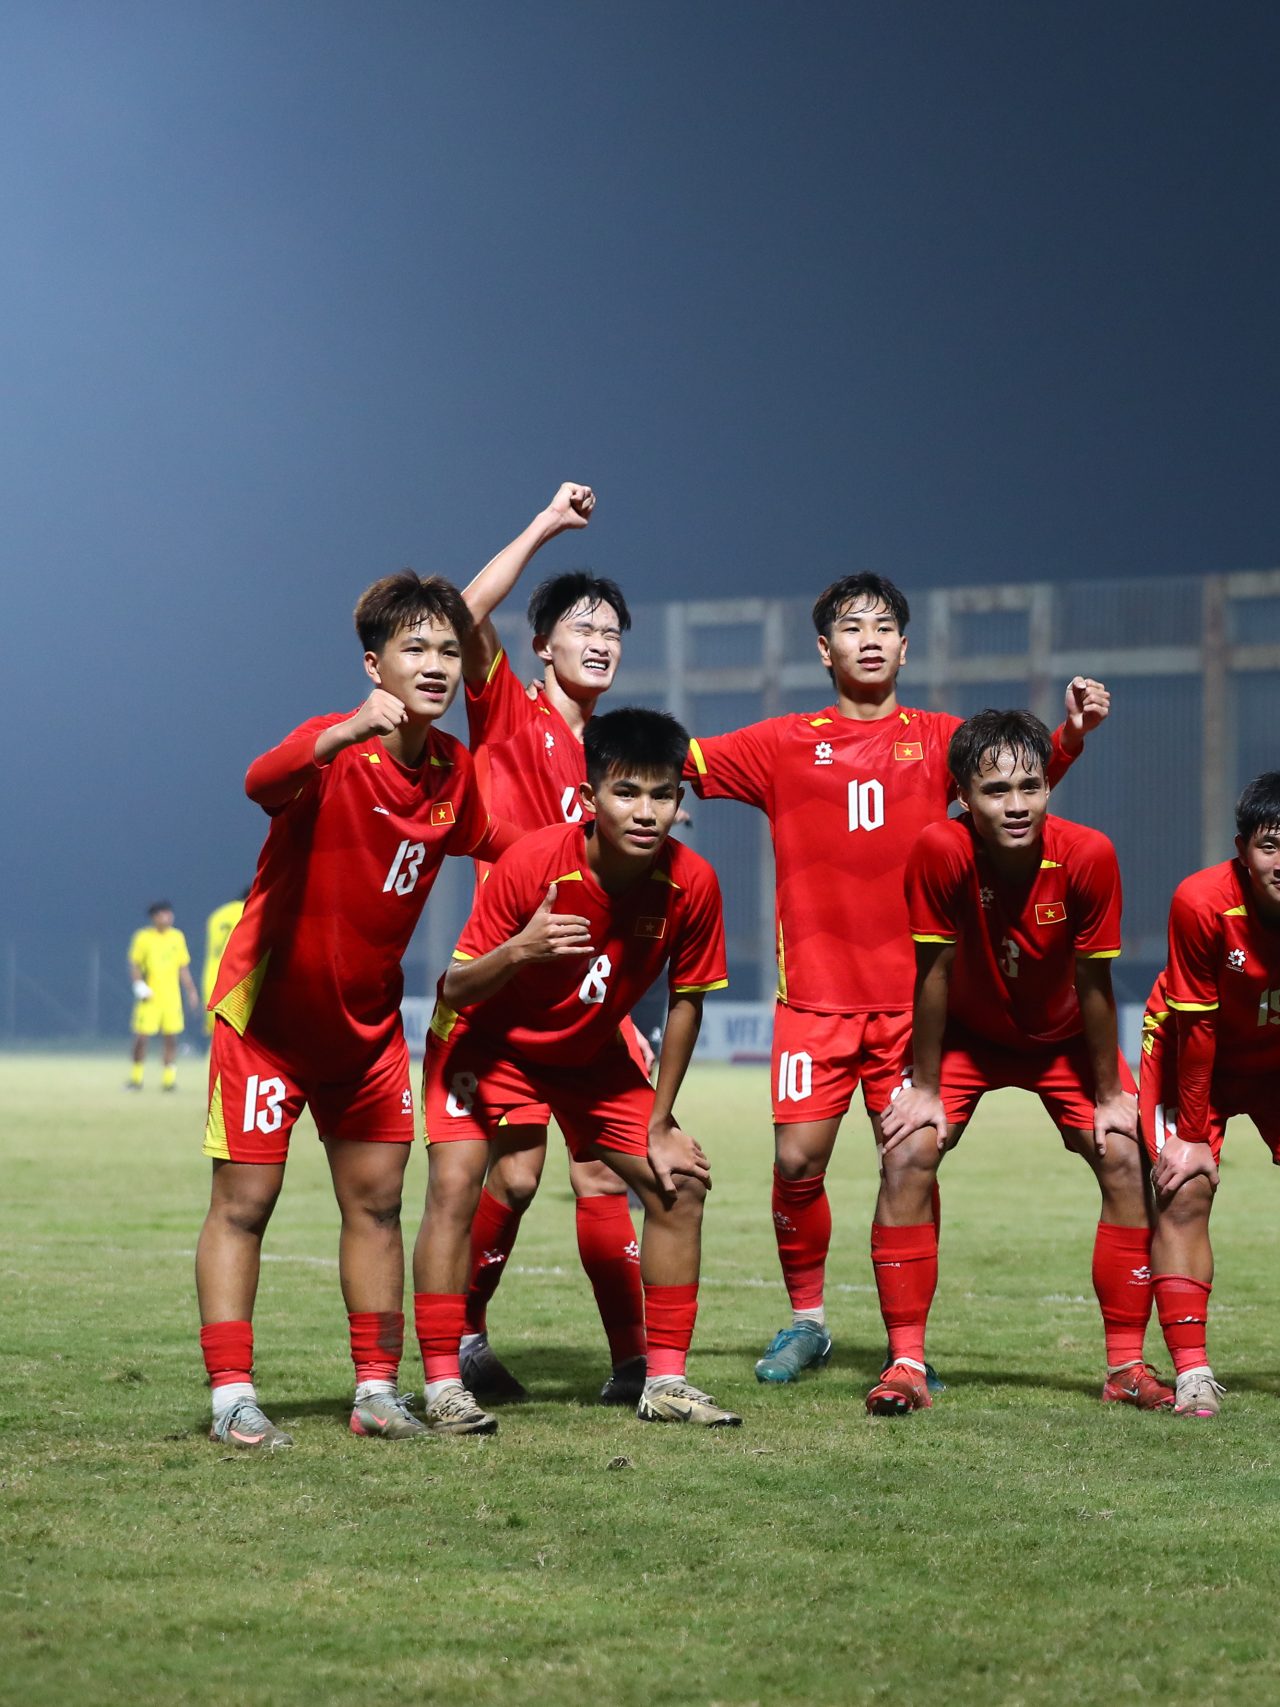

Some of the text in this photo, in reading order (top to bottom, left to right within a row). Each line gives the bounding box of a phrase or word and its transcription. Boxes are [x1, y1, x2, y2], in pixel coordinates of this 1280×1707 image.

[848, 779, 884, 832] 10
[382, 839, 426, 896] 13
[578, 954, 612, 1004] 8
[445, 1071, 479, 1118] 8
[778, 1050, 813, 1103] 10
[243, 1074, 287, 1135] 13
